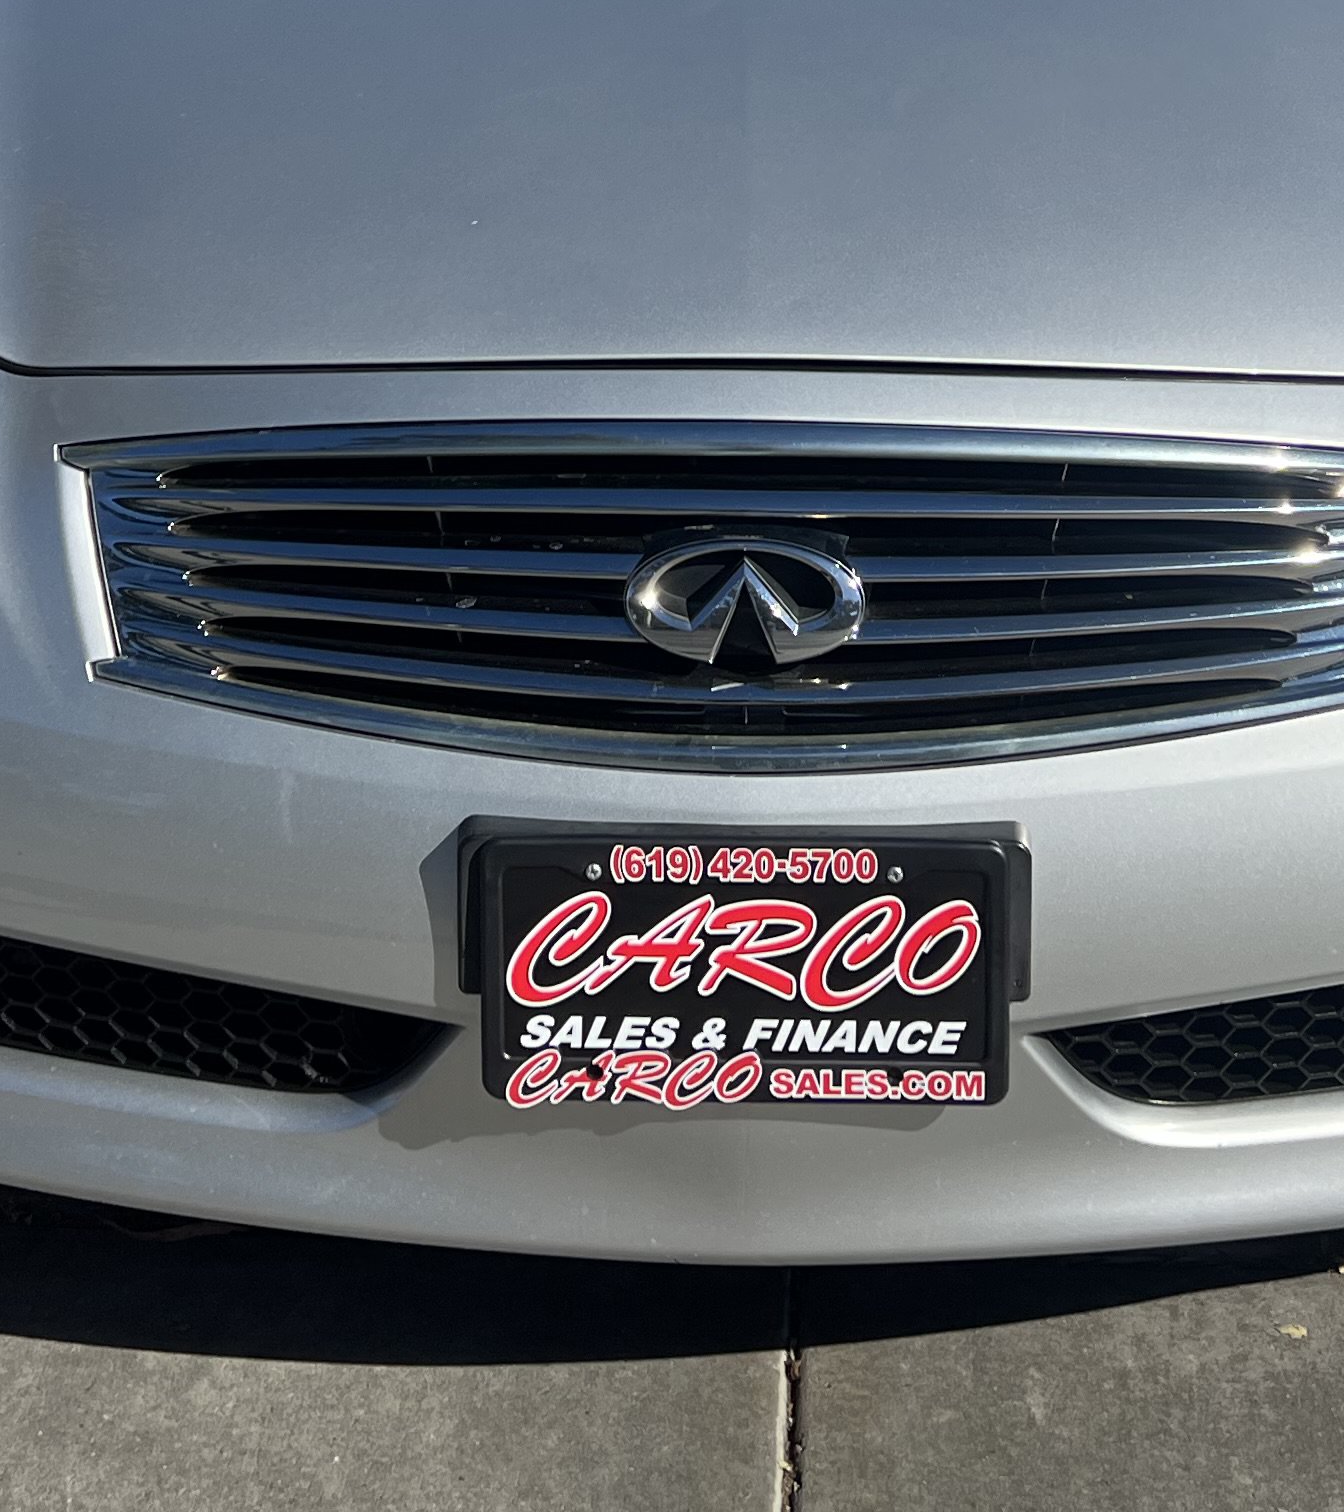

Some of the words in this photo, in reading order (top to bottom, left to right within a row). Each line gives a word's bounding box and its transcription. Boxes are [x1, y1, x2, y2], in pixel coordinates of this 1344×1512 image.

[609, 845, 703, 883] (619)
[707, 847, 878, 883] 420-5700
[506, 891, 981, 1011] CARCO
[520, 1014, 678, 1050] SALES
[692, 1016, 727, 1050] &
[739, 1018, 968, 1055] FINANCE
[506, 1048, 762, 1110] CARCO
[769, 1068, 986, 1102] SALES.COM
